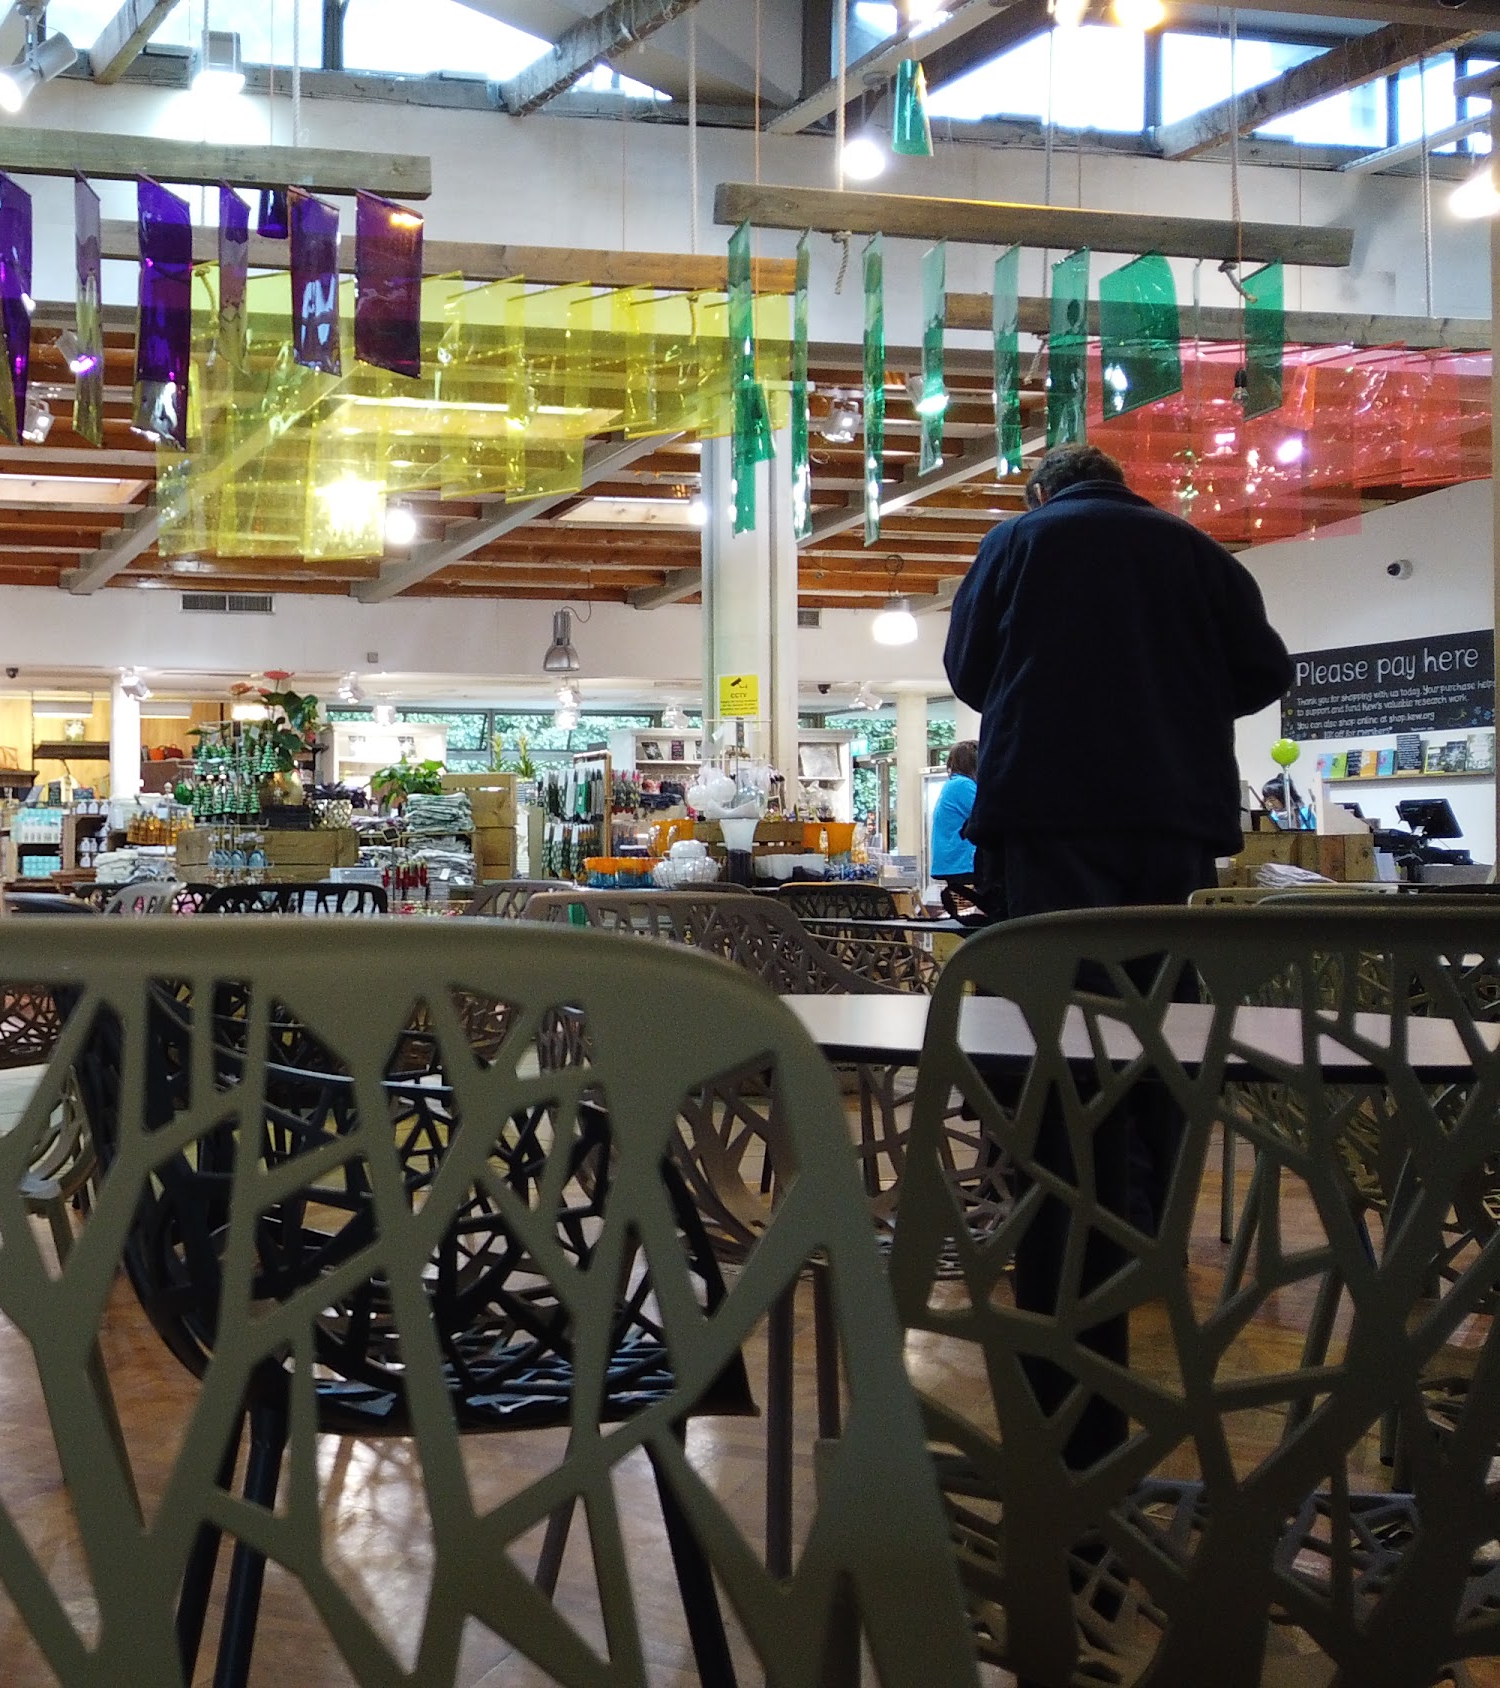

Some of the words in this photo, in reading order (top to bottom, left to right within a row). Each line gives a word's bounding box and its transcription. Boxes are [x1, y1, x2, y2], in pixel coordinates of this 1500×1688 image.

[1296, 660, 1369, 687] Please
[1377, 653, 1416, 683] pay
[1424, 647, 1479, 673] here
[1297, 697, 1318, 706] Thank
[1341, 692, 1372, 702] shopping
[1373, 689, 1389, 698] with
[1422, 684, 1440, 694] Your
[1440, 682, 1476, 694] purchase
[1305, 707, 1330, 717] support
[1330, 705, 1345, 714] and
[1345, 703, 1361, 712] fund
[1362, 702, 1382, 711] Kew's
[1384, 699, 1413, 709] valuable
[1414, 696, 1447, 707] research
[1296, 721, 1309, 731] You
[1309, 721, 1323, 729] can
[1323, 720, 1337, 728] also
[1338, 718, 1355, 727] shop
[1356, 716, 1379, 726] online
[1379, 715, 1388, 723] at
[1389, 711, 1435, 723] shop.kew.org
